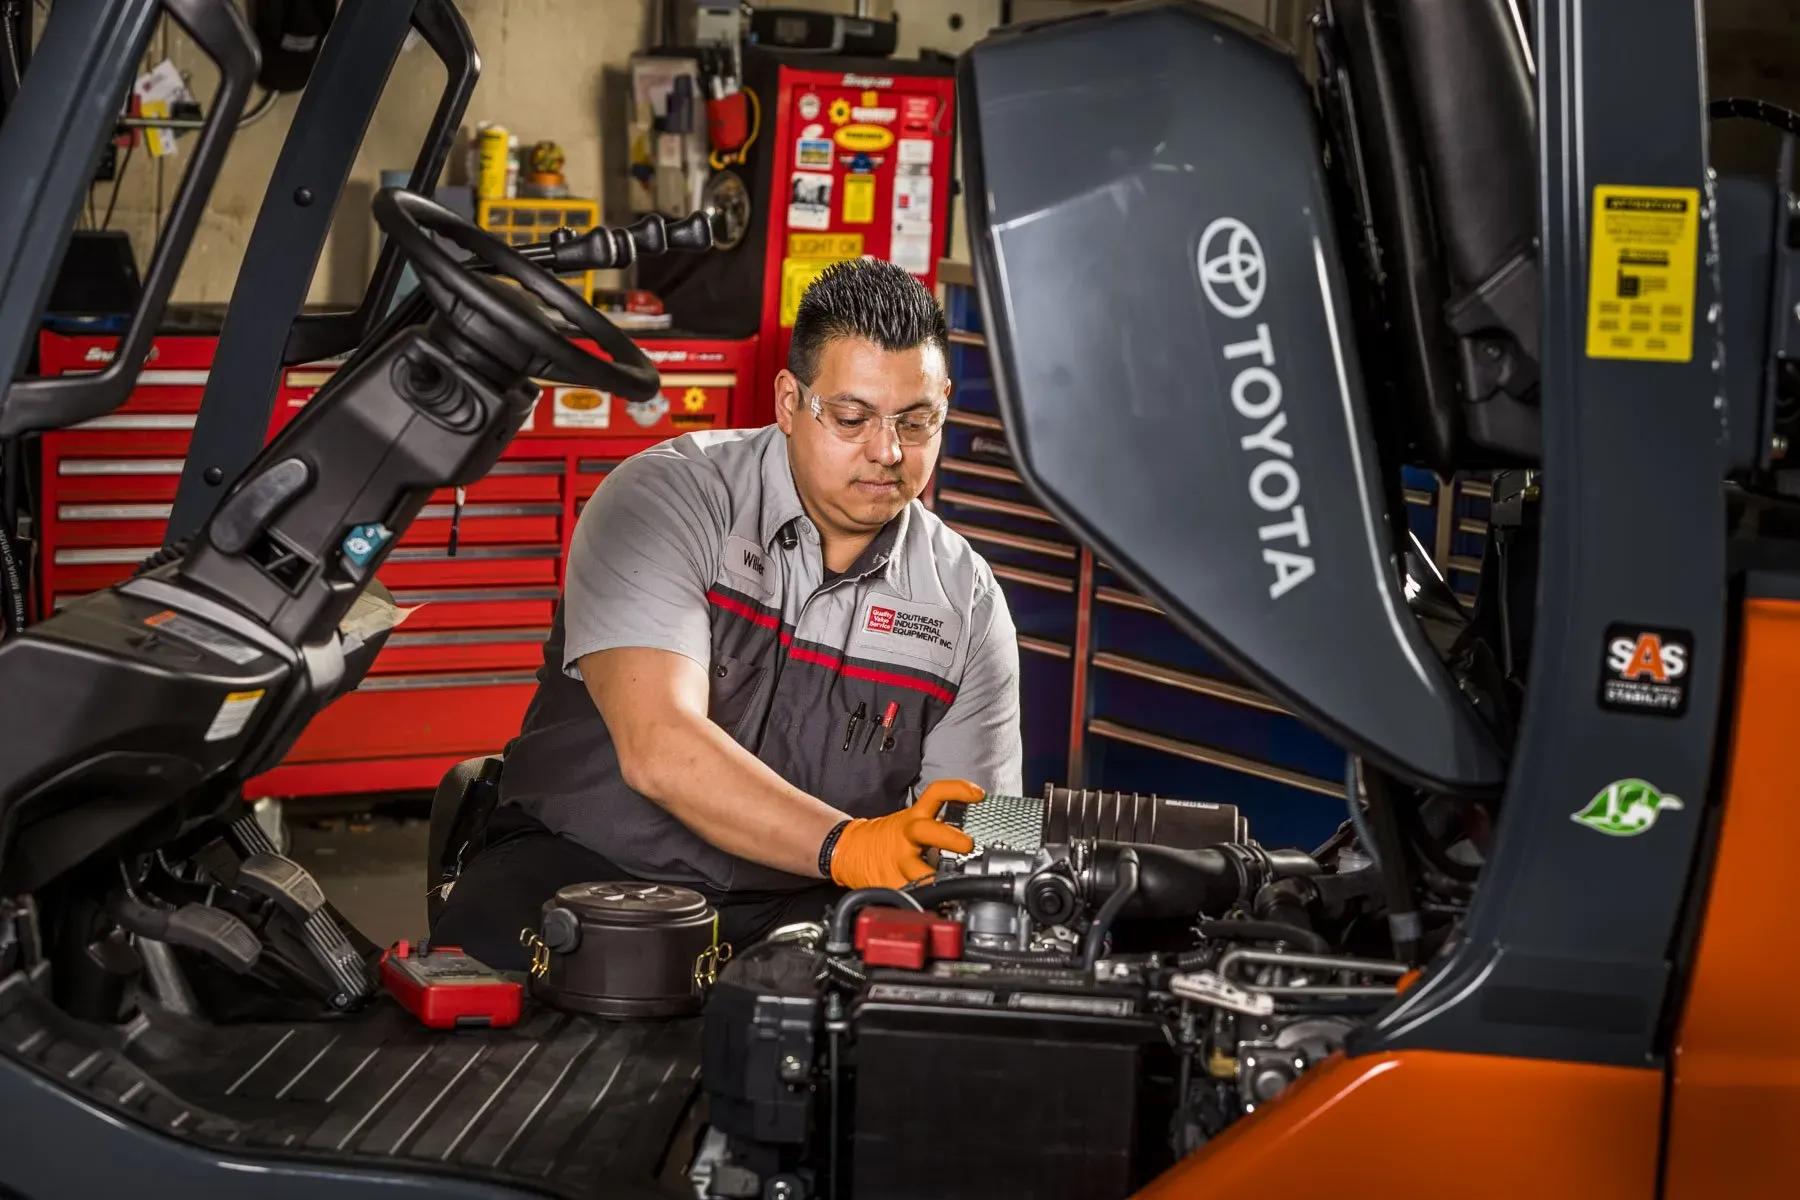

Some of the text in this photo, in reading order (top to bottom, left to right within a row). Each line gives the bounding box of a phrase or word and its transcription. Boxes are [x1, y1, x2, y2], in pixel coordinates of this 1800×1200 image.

[1223, 323, 1316, 600] TOYOTA
[872, 608, 894, 620] Quality
[896, 611, 944, 629] SOUTHEAST
[869, 620, 891, 630] Service
[895, 620, 942, 637] INDUSTRIAL
[892, 627, 953, 651] EQUIPMENT INC.
[1607, 632, 1686, 684] SAS
